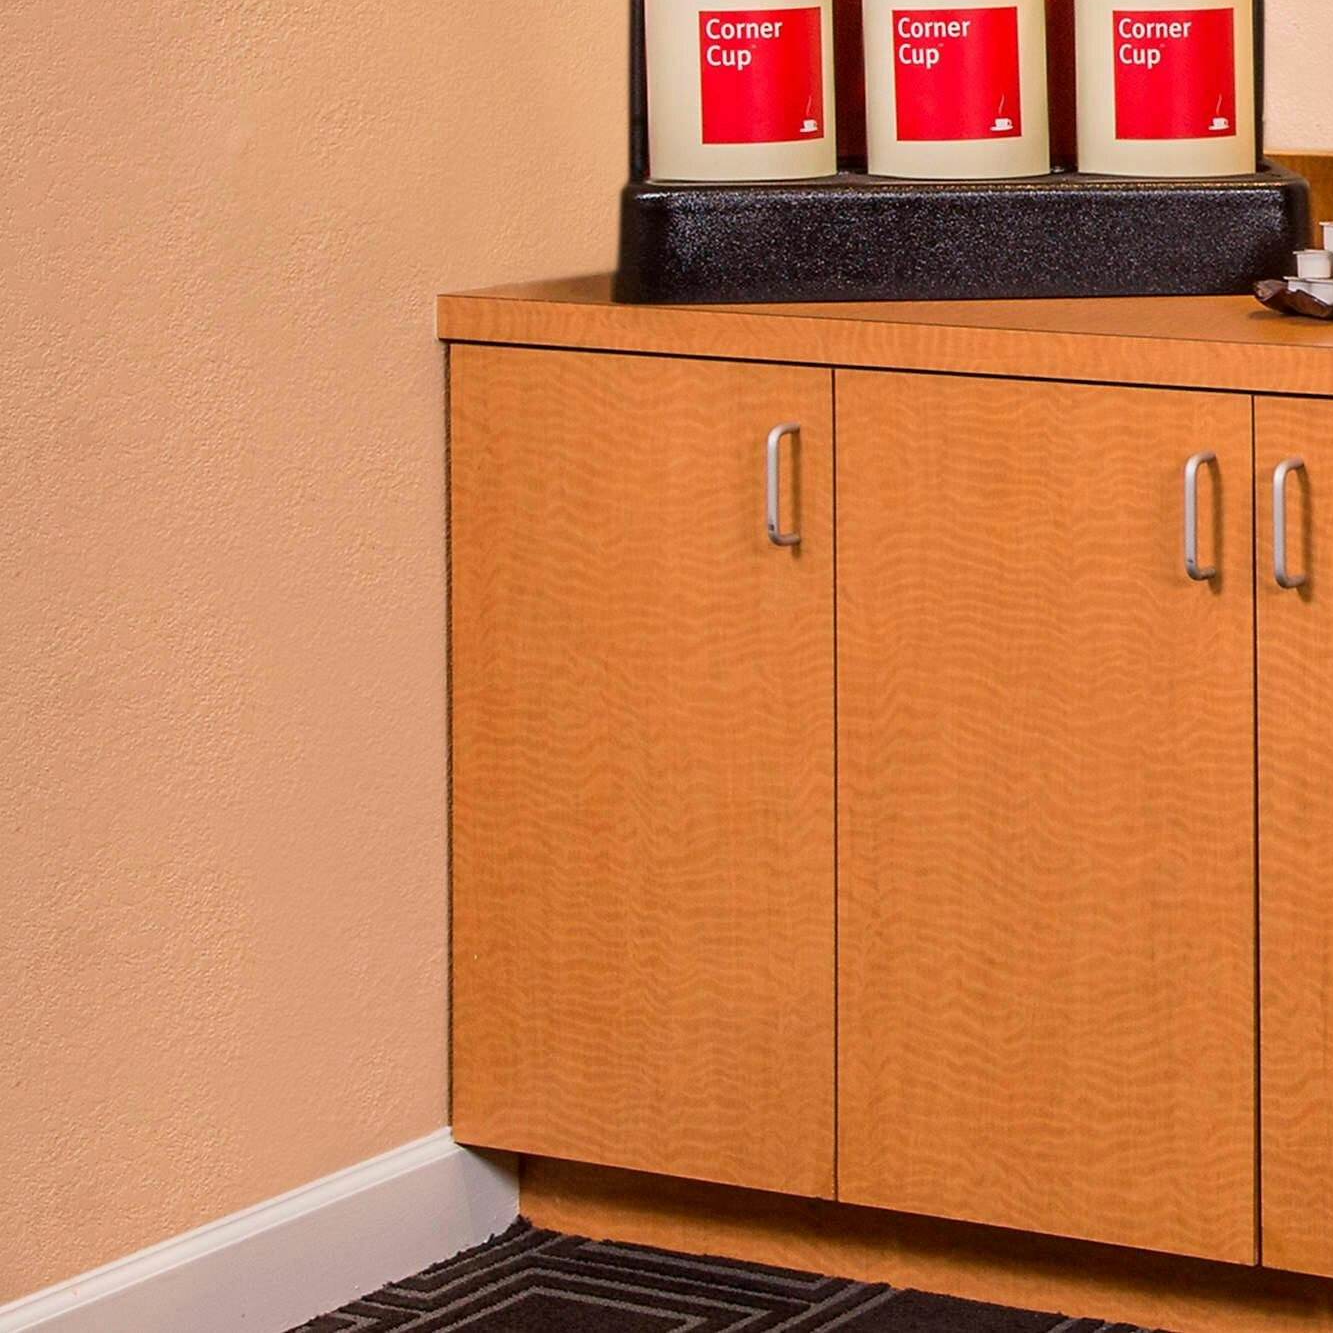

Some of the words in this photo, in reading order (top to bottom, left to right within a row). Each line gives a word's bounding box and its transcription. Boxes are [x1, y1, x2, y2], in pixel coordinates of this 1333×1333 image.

[705, 18, 783, 40] Corner
[898, 17, 971, 39] Corner
[1118, 18, 1192, 39] Corner
[706, 44, 752, 71] Cup
[898, 43, 940, 69] Cup
[1119, 43, 1161, 70] Cup
